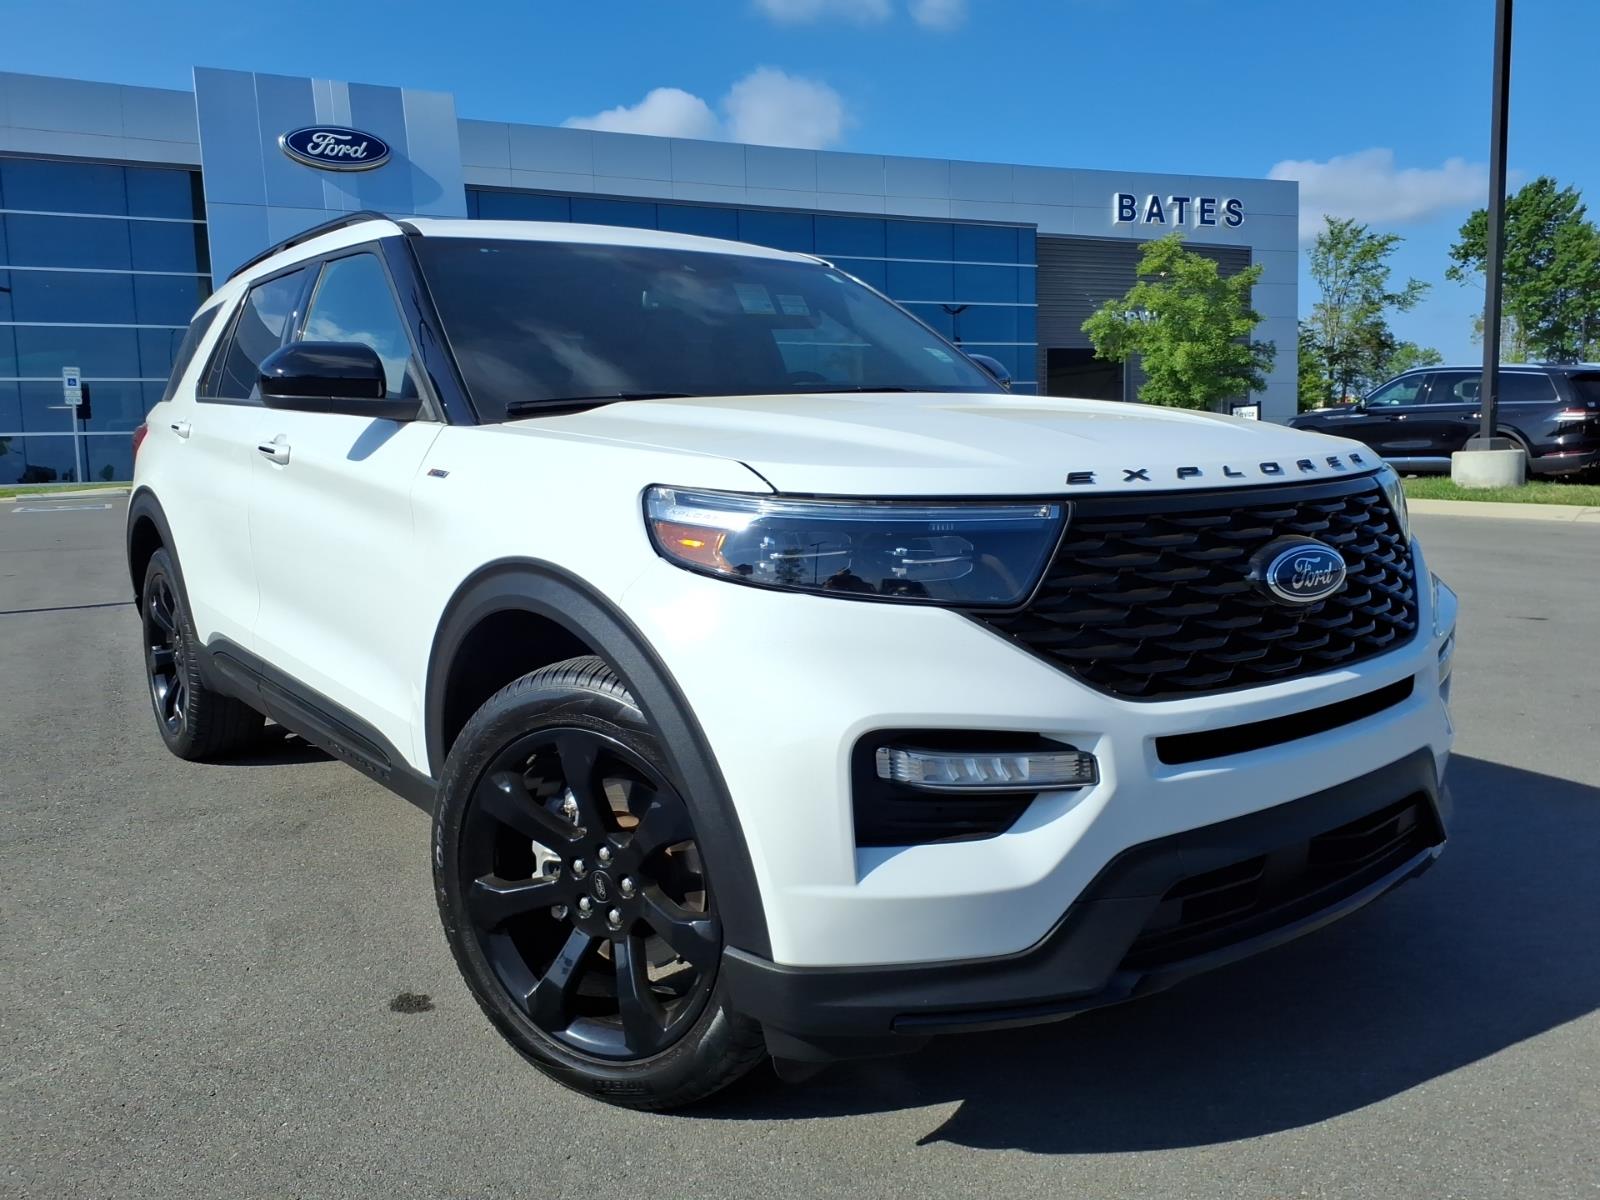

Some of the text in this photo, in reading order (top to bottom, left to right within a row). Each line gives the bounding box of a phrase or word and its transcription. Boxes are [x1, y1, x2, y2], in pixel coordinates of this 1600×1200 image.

[306, 131, 368, 159] Ford
[1114, 192, 1245, 227] BATES
[1065, 453, 1364, 485] EXPLORER
[1291, 556, 1334, 590] Ford
